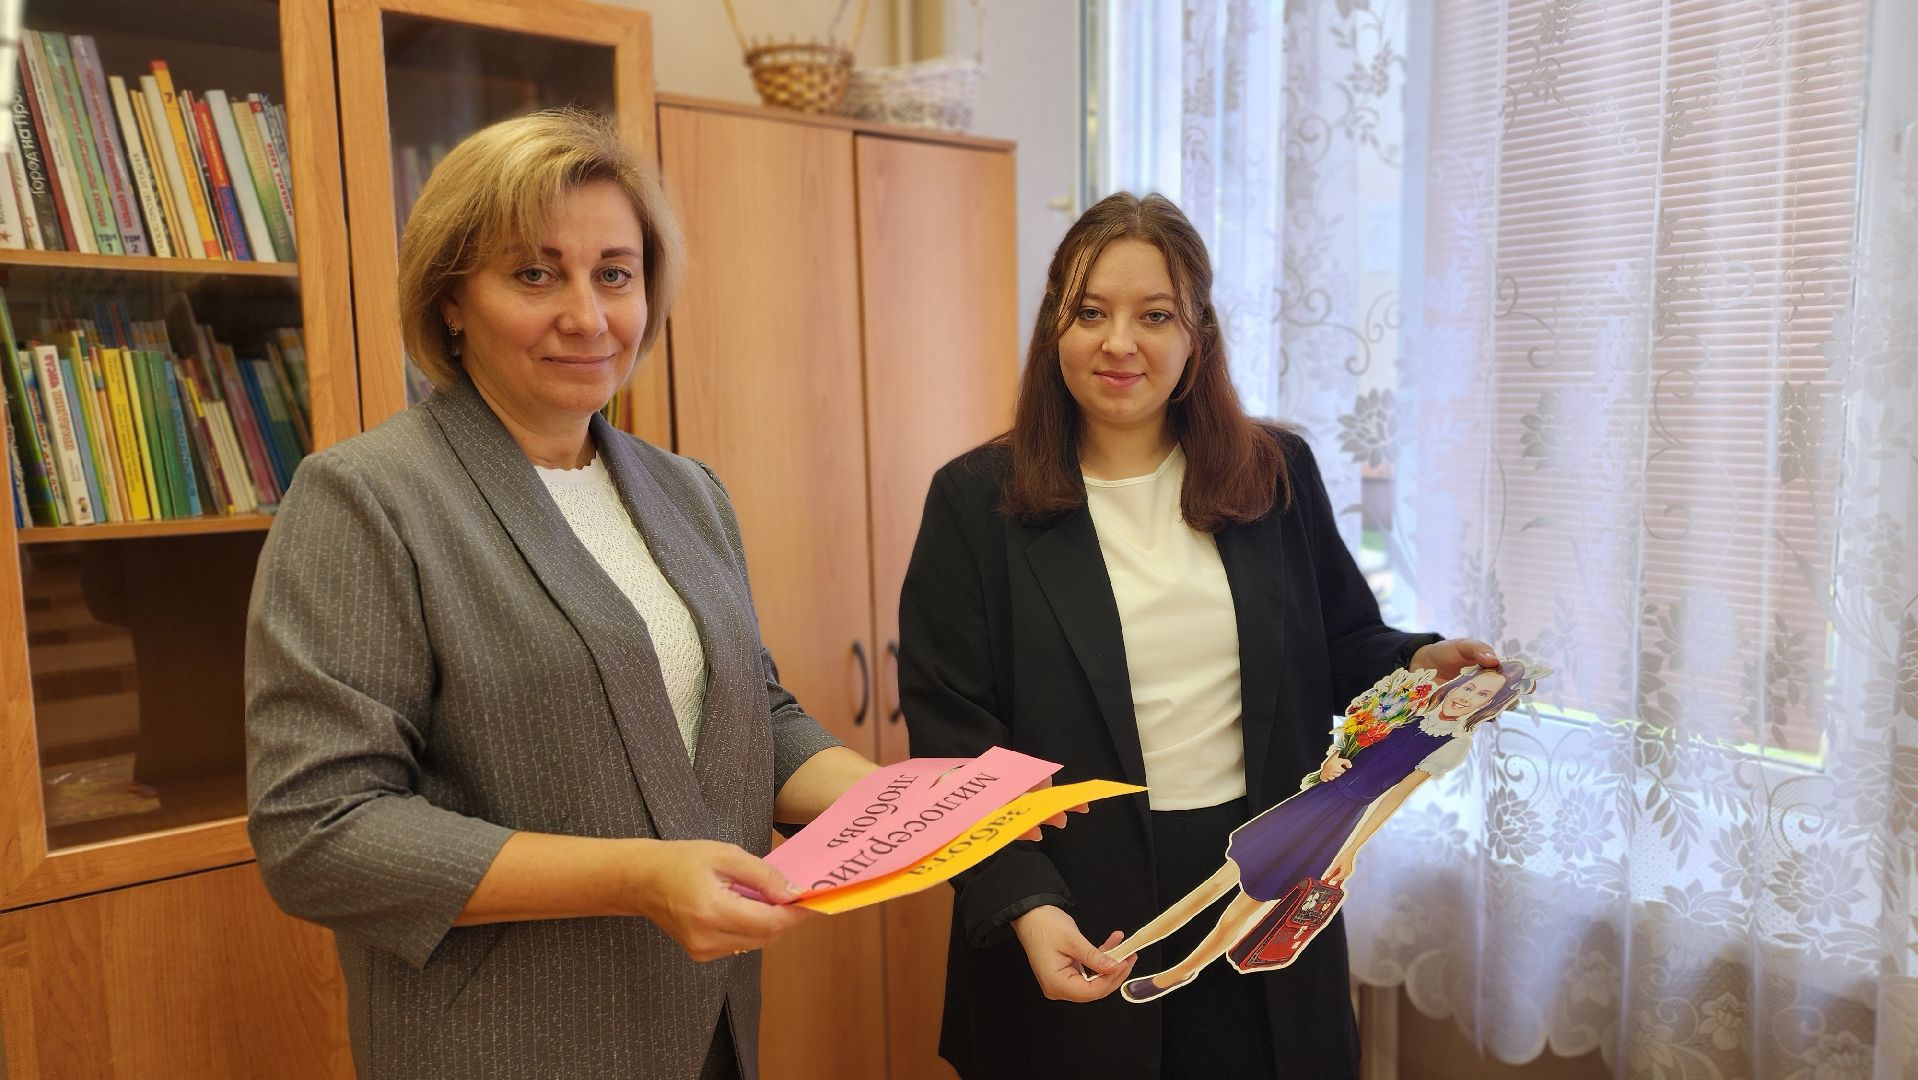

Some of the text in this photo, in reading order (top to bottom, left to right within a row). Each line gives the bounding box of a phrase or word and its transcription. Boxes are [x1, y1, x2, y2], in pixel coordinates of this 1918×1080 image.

[19, 128, 35, 149] на
[827, 774, 919, 848] любовь
[908, 807, 1031, 876] забота
